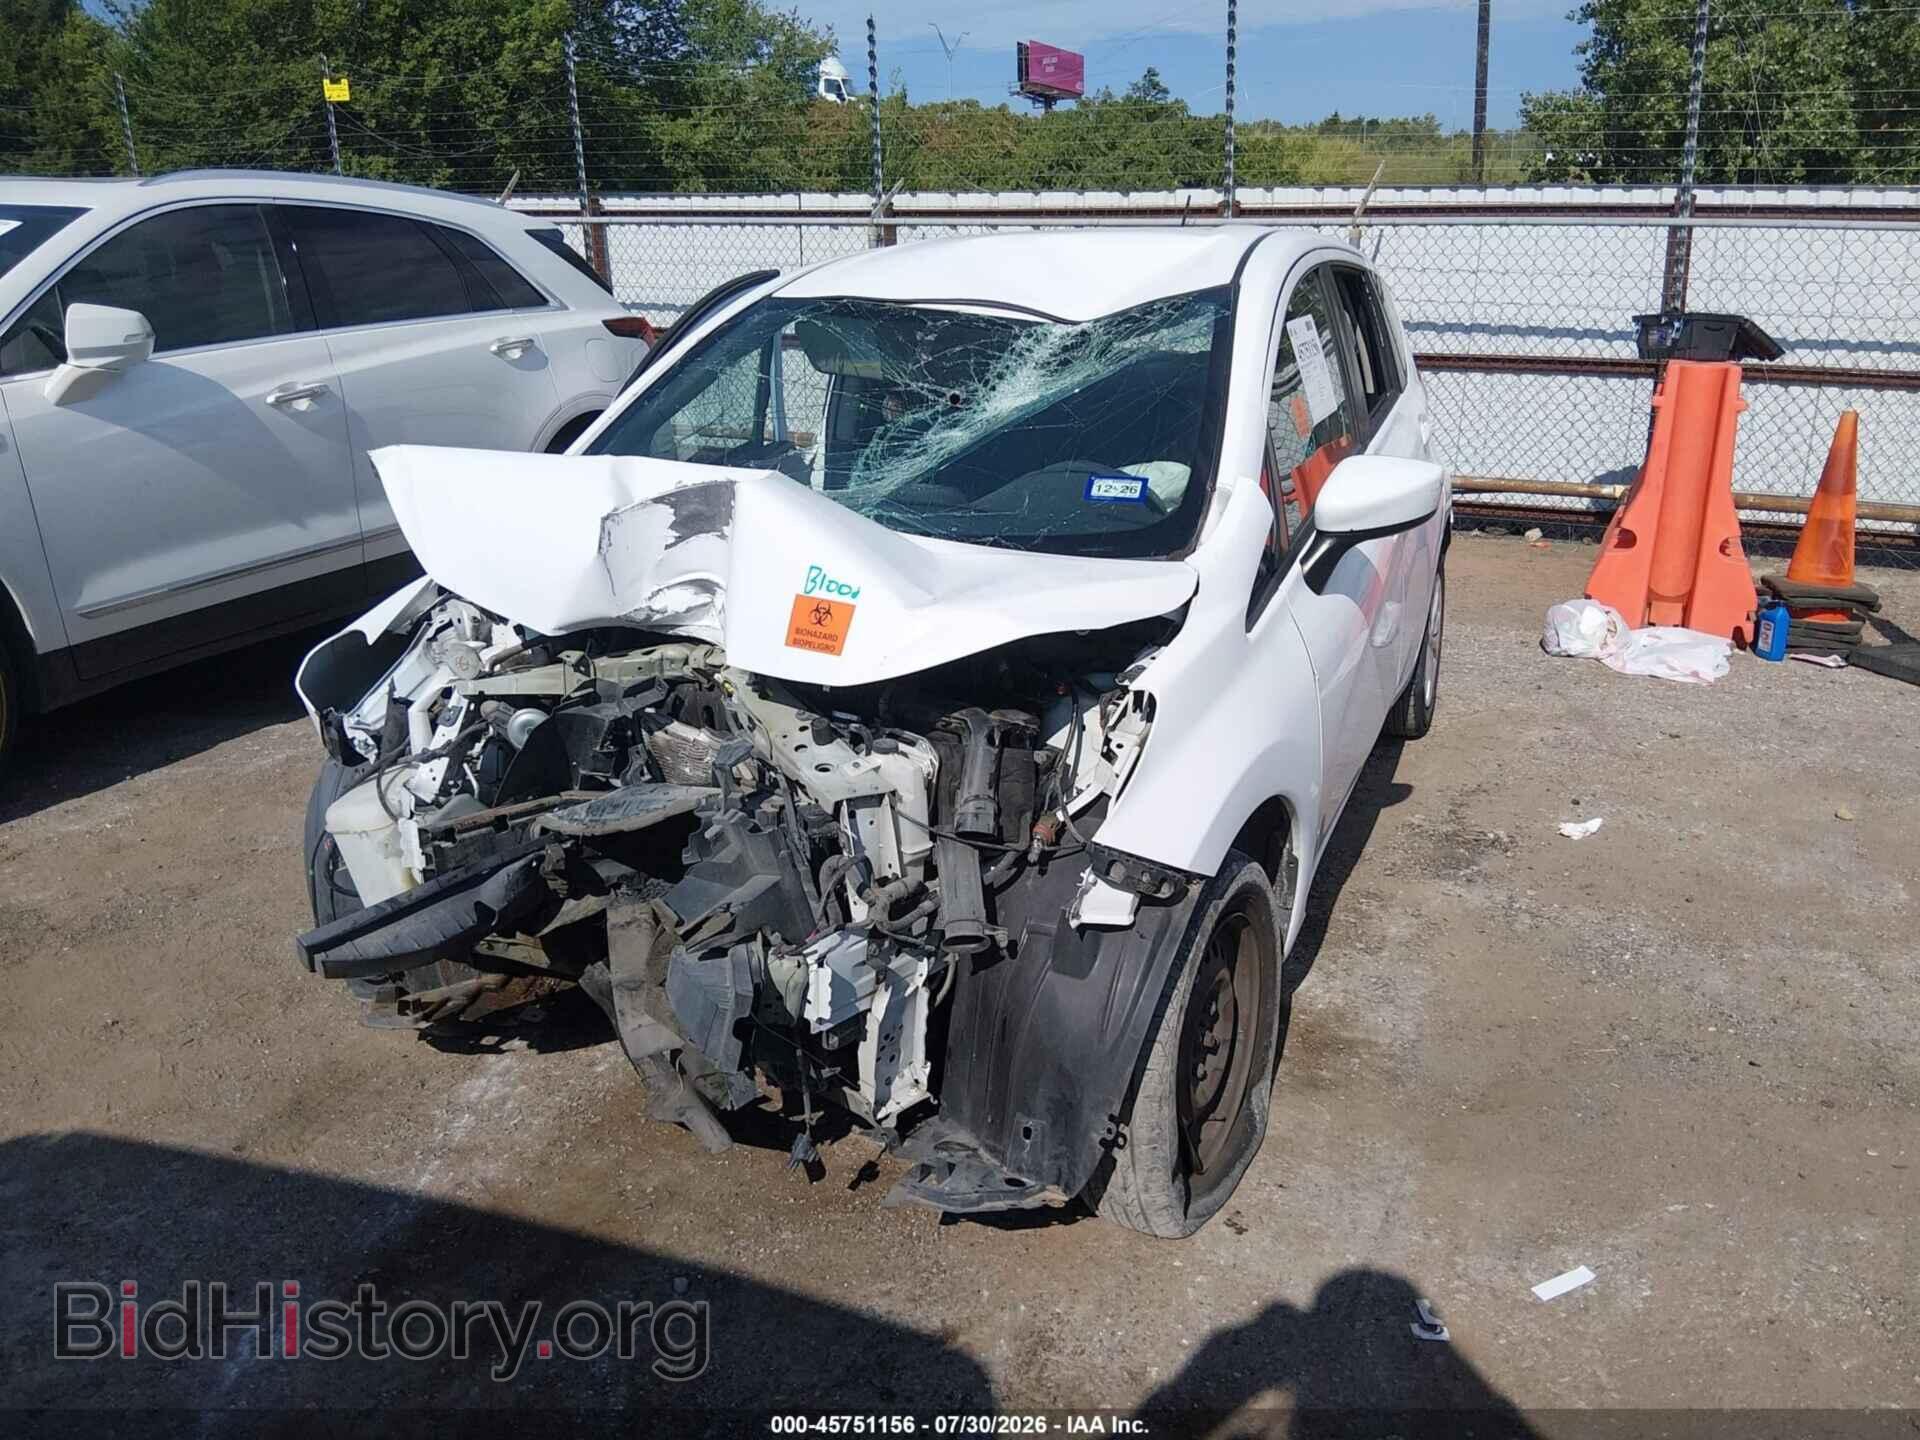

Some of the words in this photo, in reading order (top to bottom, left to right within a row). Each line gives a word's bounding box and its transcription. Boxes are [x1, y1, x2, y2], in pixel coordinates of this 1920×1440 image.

[1096, 484, 1113, 493] 12
[1120, 485, 1138, 494] 26
[795, 627, 839, 642] BIOHAZARD
